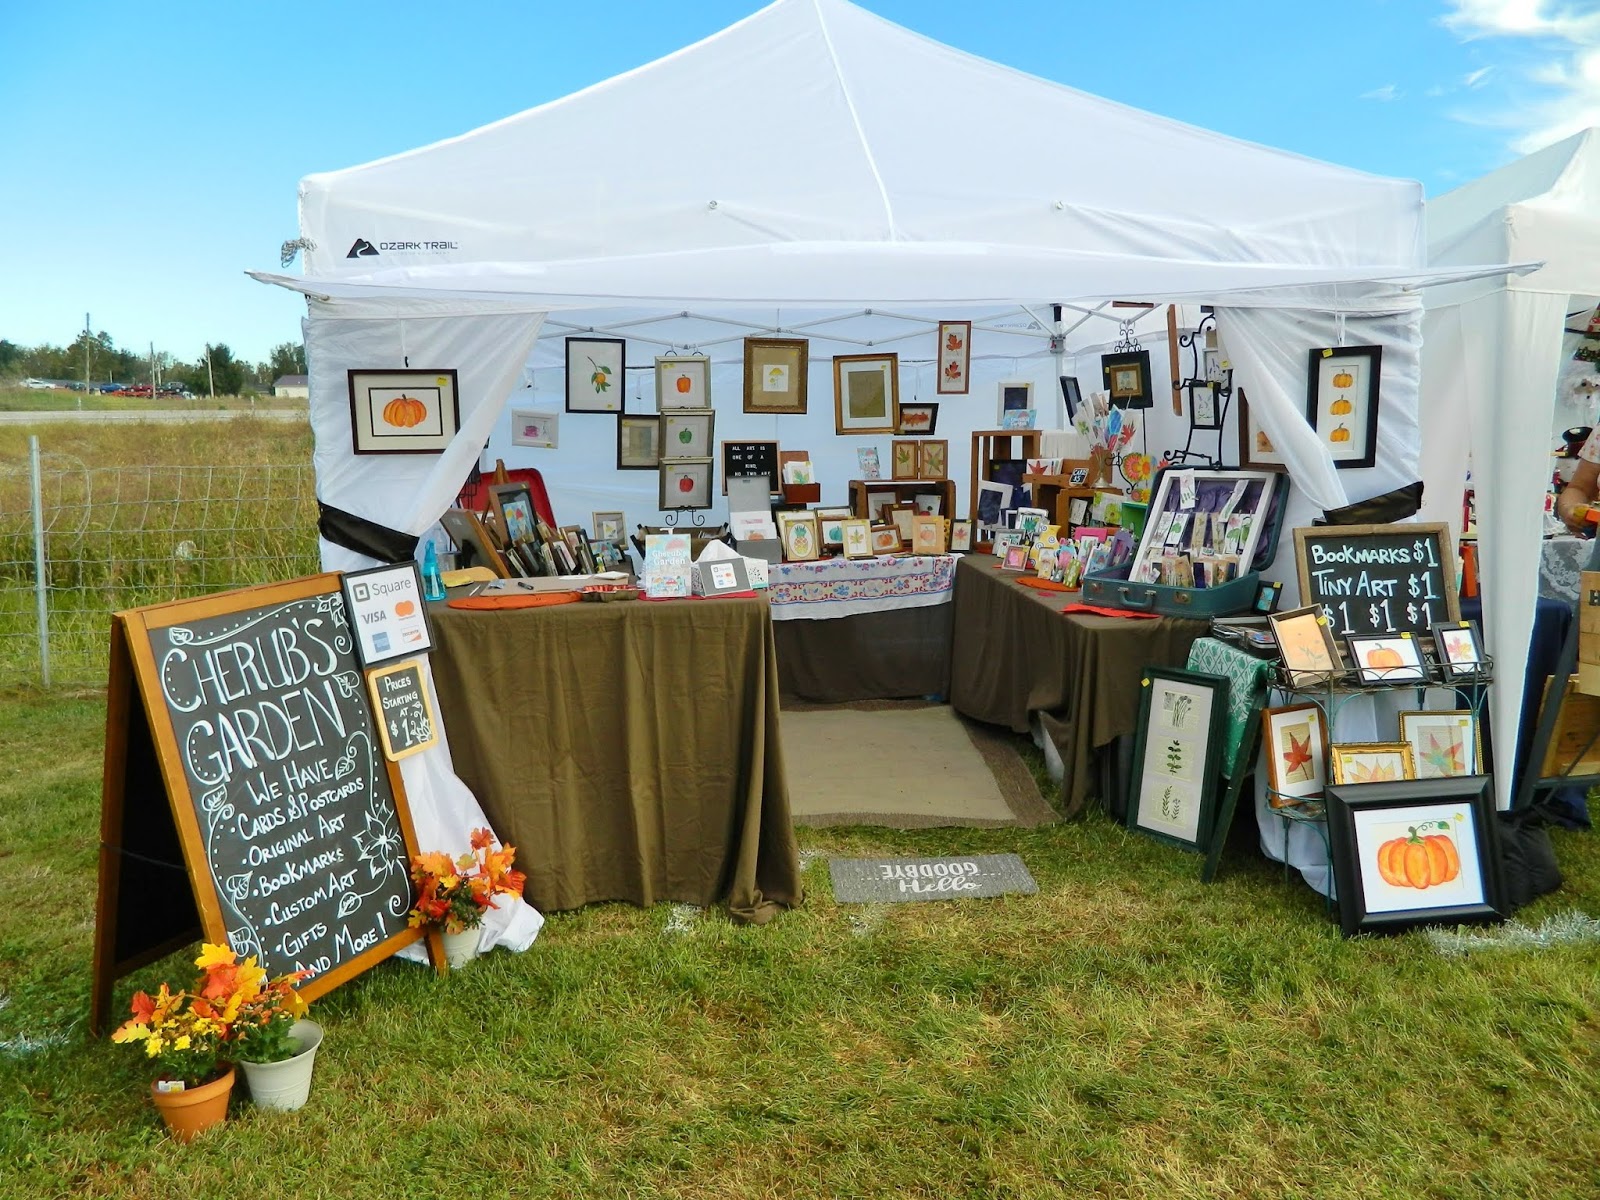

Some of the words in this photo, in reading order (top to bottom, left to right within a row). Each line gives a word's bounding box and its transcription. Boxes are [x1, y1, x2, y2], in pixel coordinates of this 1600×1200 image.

[380, 242, 422, 250] OZARK
[423, 242, 458, 250] TRAIL
[1413, 538, 1438, 568] $1
[372, 580, 412, 596] Square
[1356, 570, 1398, 597] ART
[1408, 571, 1440, 600] $1
[362, 610, 387, 624] VISA
[162, 618, 338, 713] CHERUB'S
[384, 676, 412, 692] PRICES
[382, 691, 418, 710] STARTING
[187, 680, 346, 786] GARDEN
[246, 772, 282, 806] WE
[283, 758, 334, 792] HAVE
[238, 810, 286, 840] CARDS
[300, 777, 364, 816] POSTCARDS
[250, 828, 314, 866] ORIGINAL
[319, 814, 346, 838] ART
[328, 868, 358, 898] ART
[880, 862, 978, 880] GOODBYE
[900, 877, 982, 894] Hello
[282, 922, 328, 957] GIFTS
